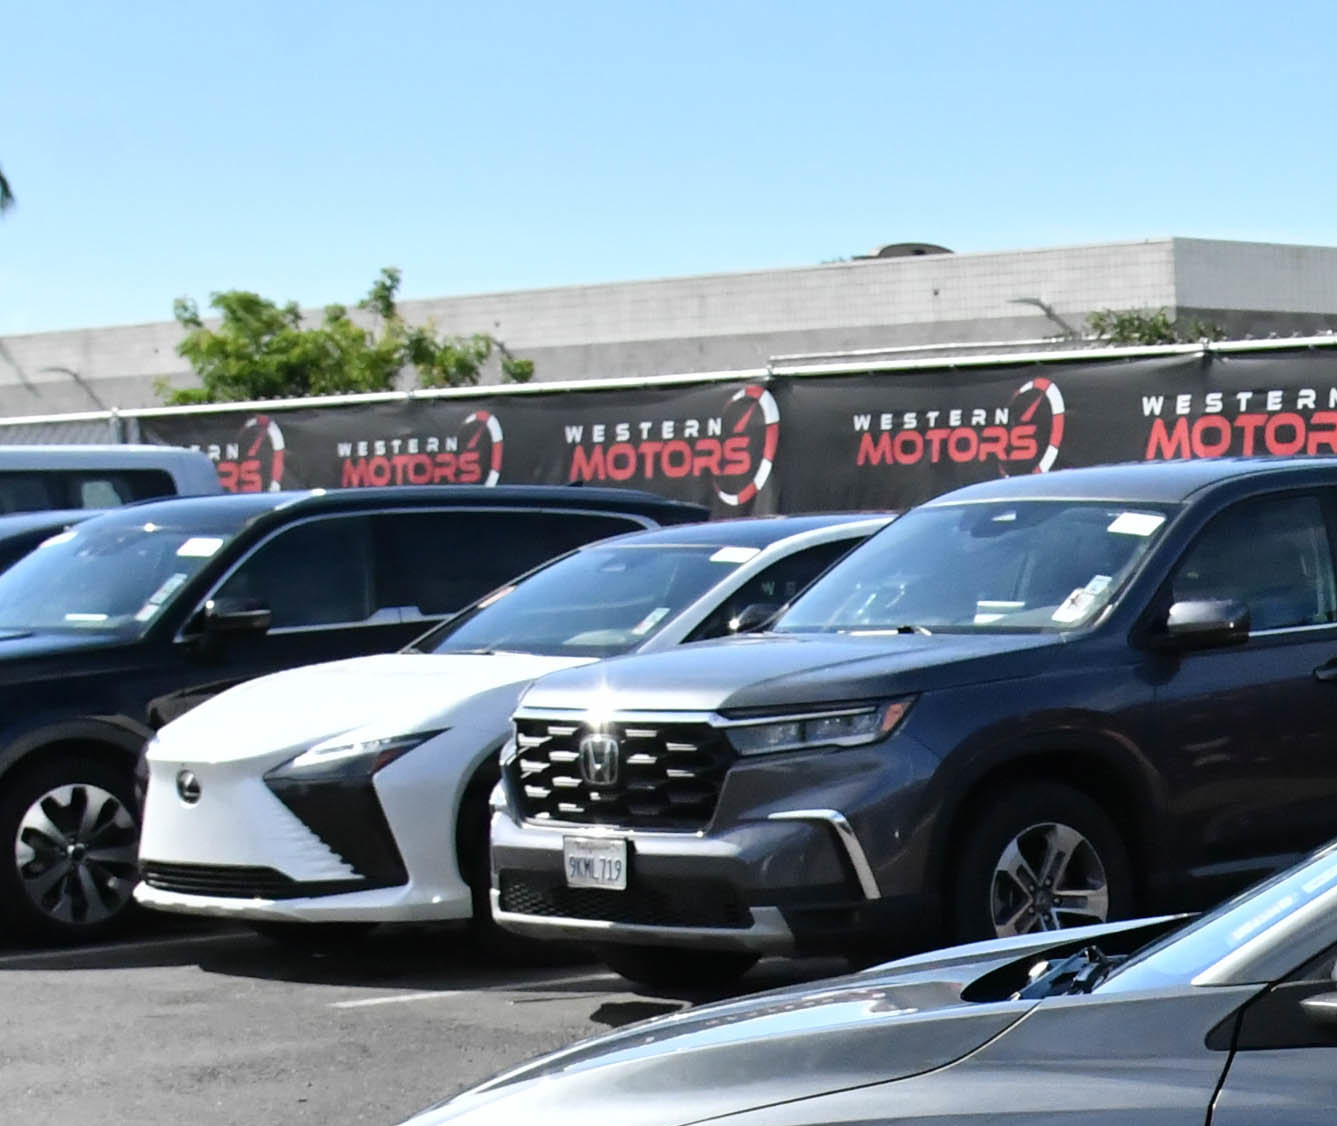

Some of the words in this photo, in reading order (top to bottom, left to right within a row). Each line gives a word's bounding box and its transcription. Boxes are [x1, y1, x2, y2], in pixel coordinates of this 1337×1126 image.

[565, 417, 722, 443] WESTERN
[853, 408, 1009, 431] WESTERN
[337, 437, 458, 457] WESTERN
[570, 436, 752, 481] MOTORS
[857, 425, 1038, 466] MOTORS
[342, 451, 481, 488] MOTORS
